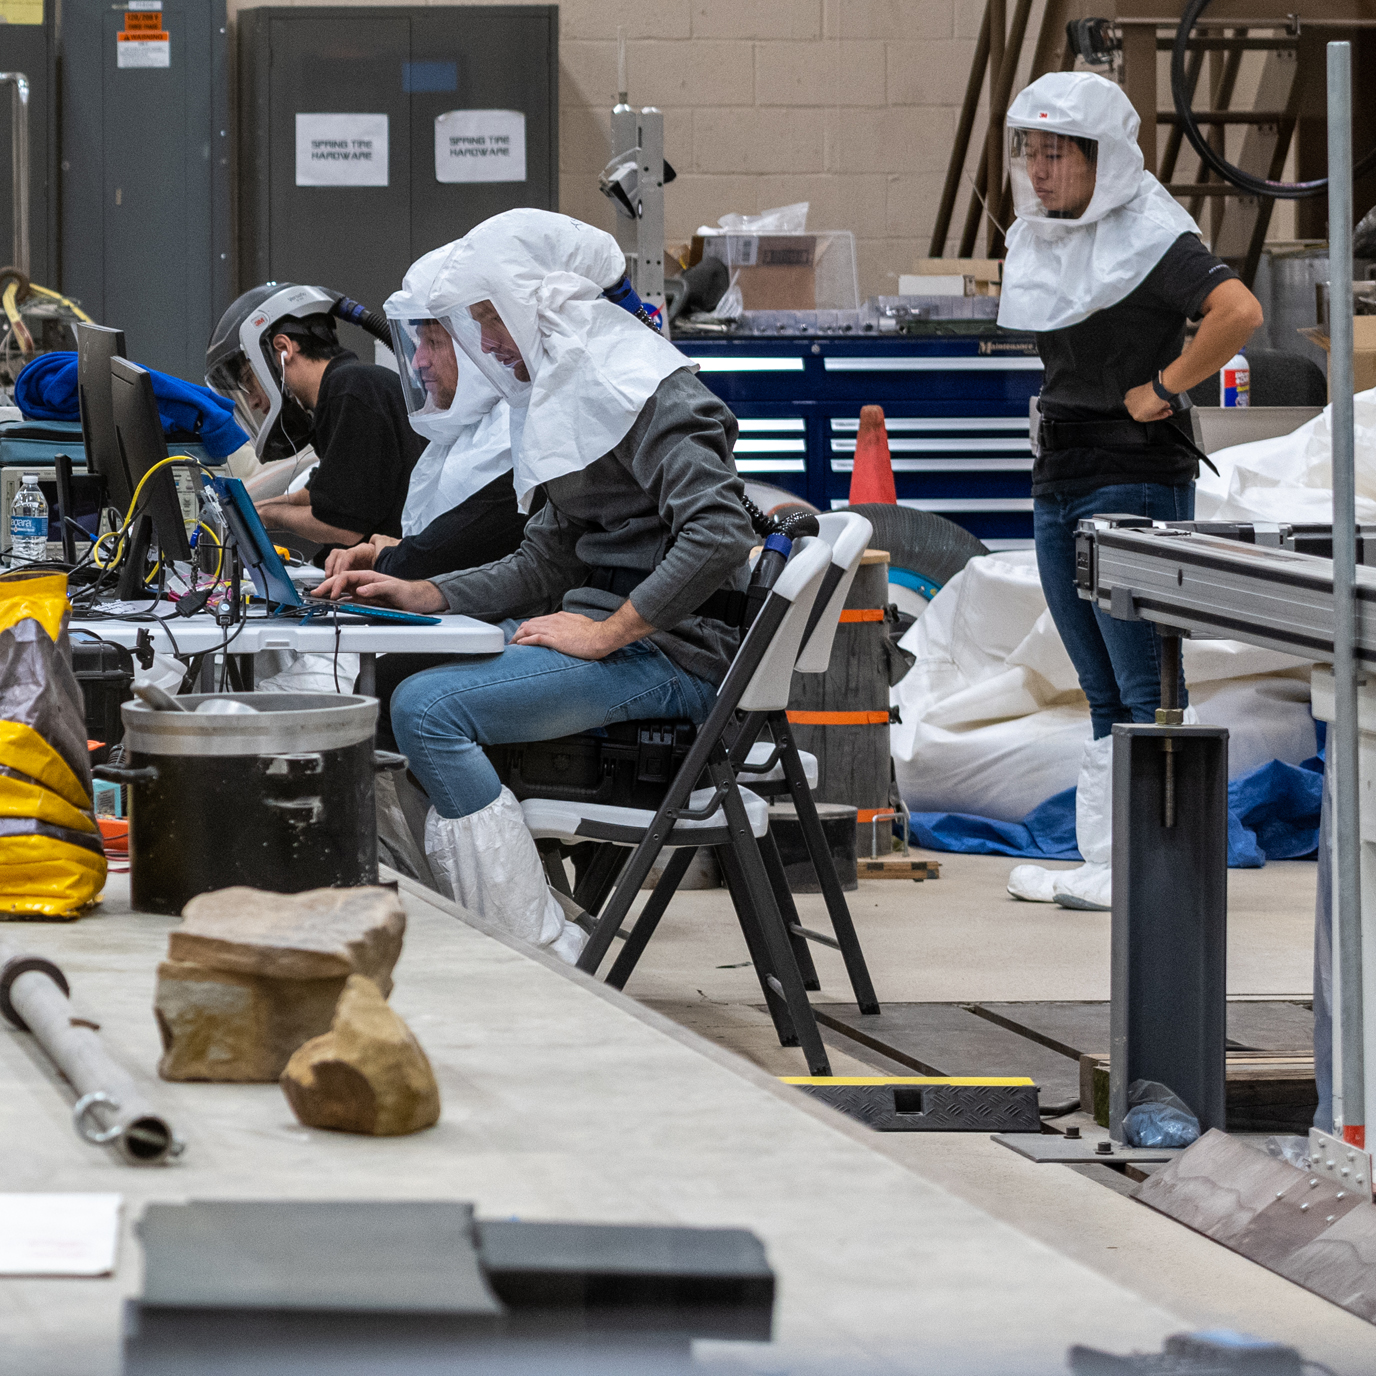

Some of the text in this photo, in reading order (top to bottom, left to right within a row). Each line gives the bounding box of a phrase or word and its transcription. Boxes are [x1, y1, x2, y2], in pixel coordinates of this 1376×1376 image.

[311, 140, 372, 149] SPRING TIRE
[449, 135, 510, 146] SPRING TIRE
[311, 151, 373, 161] HARDWARE
[449, 147, 510, 157] HARDWARE
